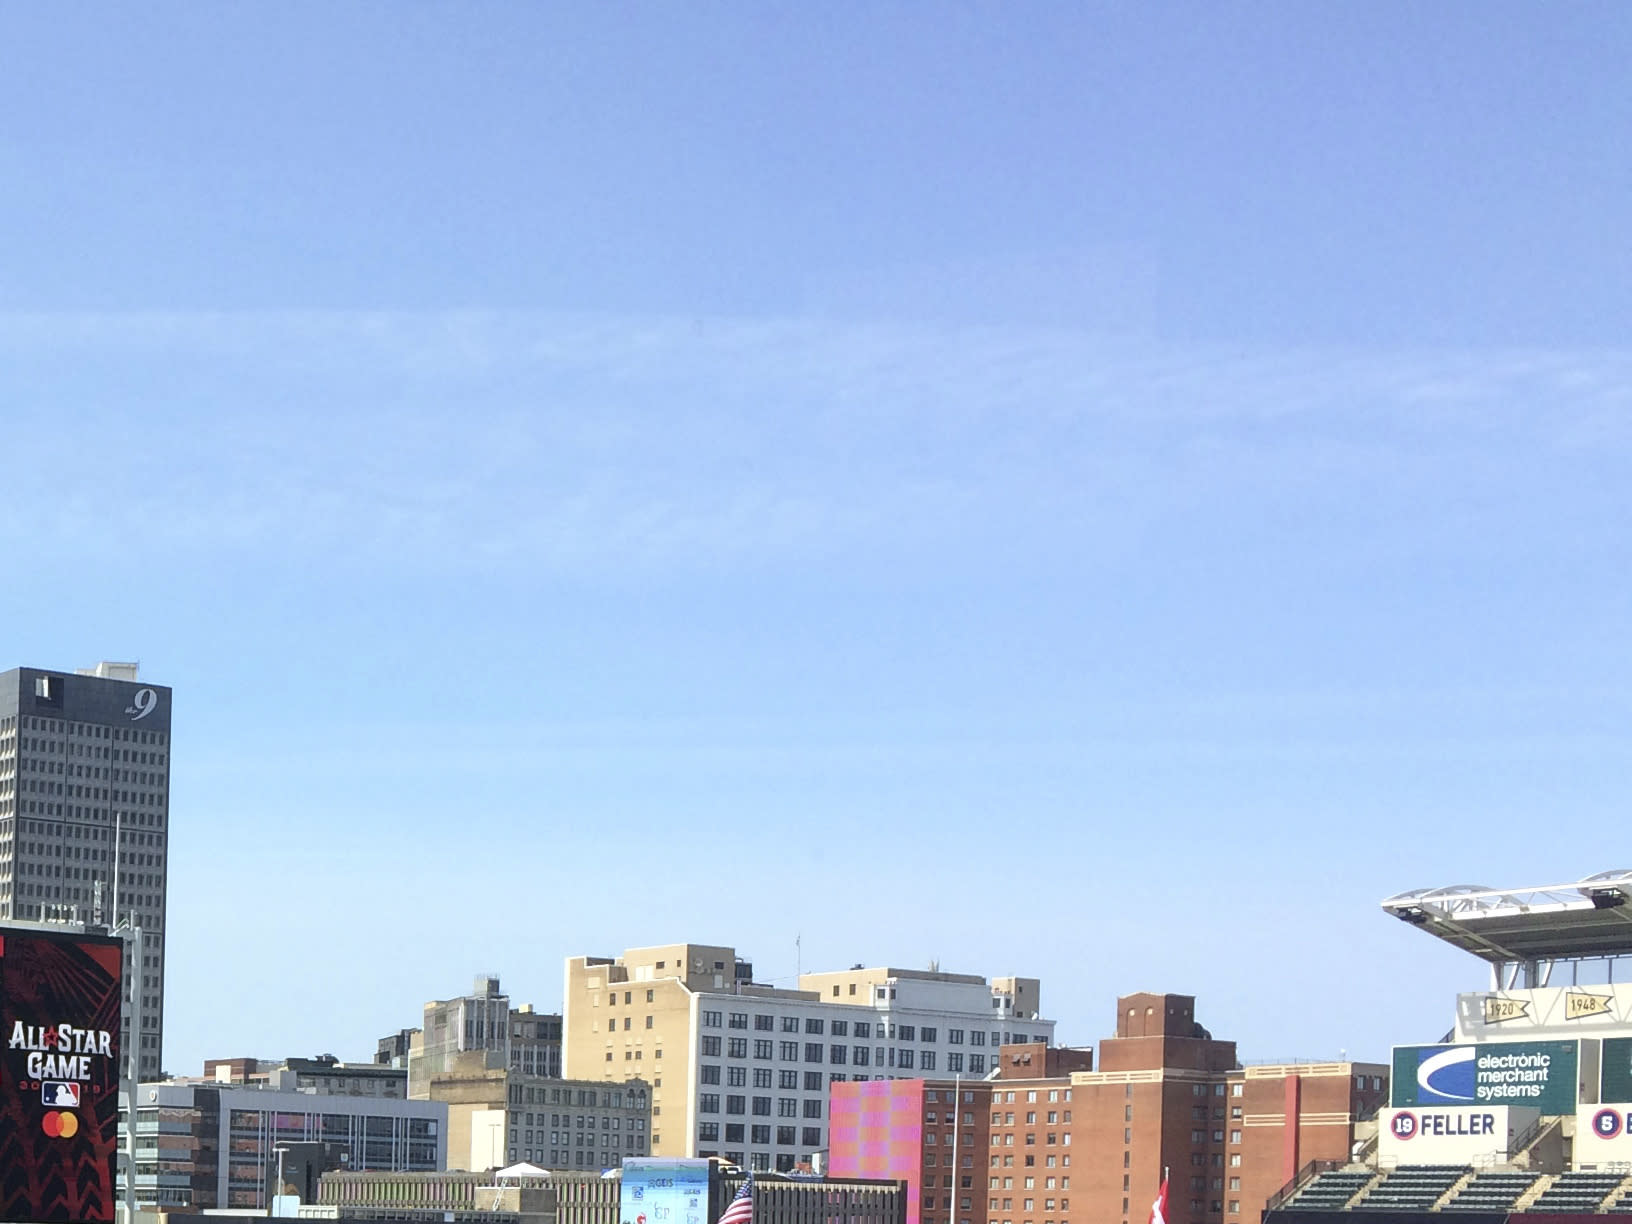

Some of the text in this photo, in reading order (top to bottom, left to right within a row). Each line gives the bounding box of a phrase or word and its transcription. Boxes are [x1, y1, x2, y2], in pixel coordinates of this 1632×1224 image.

[1490, 1003, 1514, 1017] 1920
[1571, 997, 1596, 1011] 1948
[8, 1020, 113, 1058] ALL STAR
[27, 1052, 91, 1080] GAME
[1478, 1052, 1550, 1068] electronic
[1478, 1068, 1548, 1082] merchant
[1477, 1084, 1542, 1101] systems
[1396, 1114, 1495, 1136] 19 FELLER
